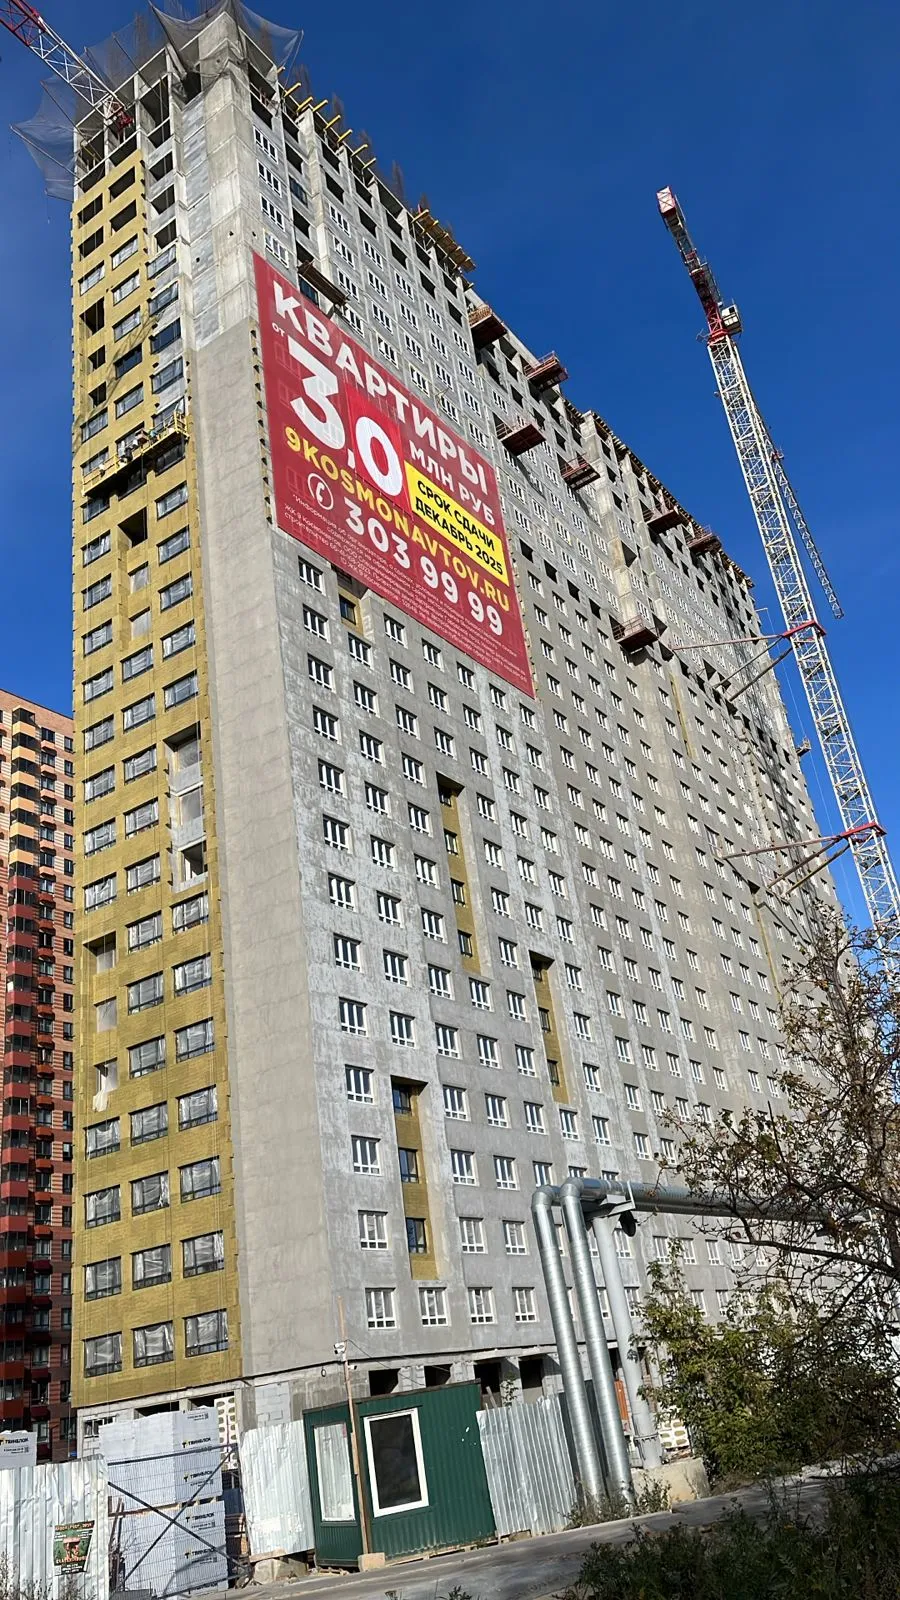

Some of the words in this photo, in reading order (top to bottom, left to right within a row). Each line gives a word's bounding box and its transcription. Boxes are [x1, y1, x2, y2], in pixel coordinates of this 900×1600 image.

[271, 322, 285, 337] от
[274, 280, 488, 495] КВАРТИРЫ
[285, 426, 511, 612] 9KOSMONAVTOV.RU
[410, 440, 453, 487] МЛН
[459, 483, 495, 526] РУБ
[417, 480, 452, 516] СРОК
[454, 506, 495, 552] СДАЧИ
[345, 497, 411, 569] 303
[421, 555, 459, 604] 99
[467, 591, 503, 636] 99
[415, 495, 474, 555] ДЕКАБРЬ
[475, 542, 503, 576] 2025
